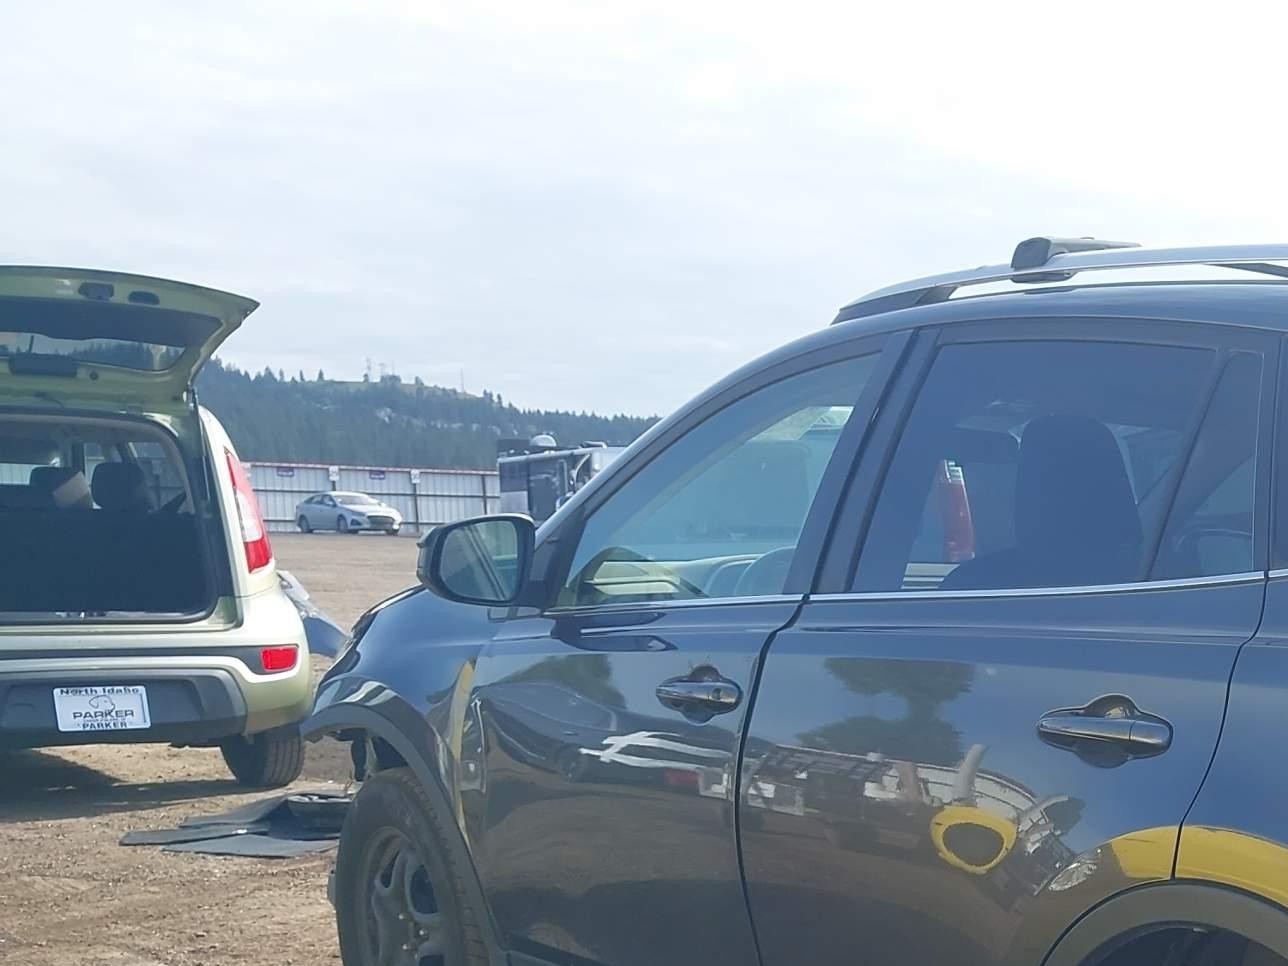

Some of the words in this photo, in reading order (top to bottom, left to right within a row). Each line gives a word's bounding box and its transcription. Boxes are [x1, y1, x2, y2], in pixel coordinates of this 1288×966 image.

[60, 687, 98, 696] North
[102, 686, 140, 695] Idaho
[73, 709, 135, 719] PARKER
[82, 721, 128, 730] PARKER
